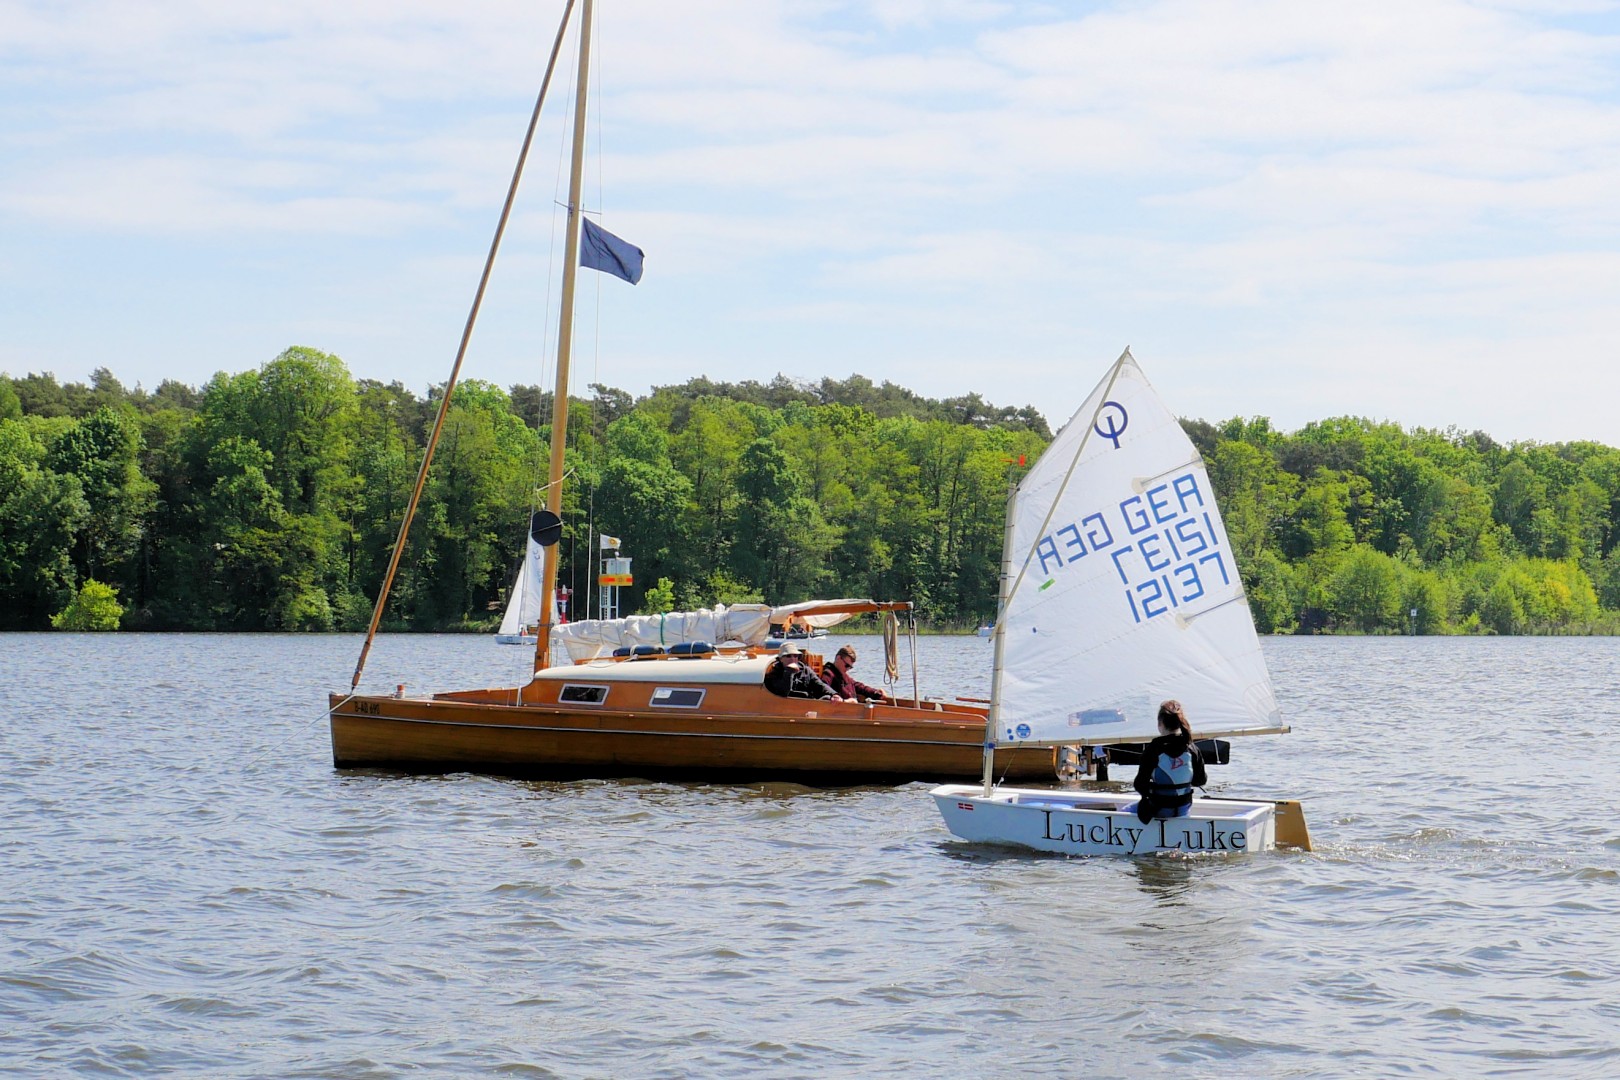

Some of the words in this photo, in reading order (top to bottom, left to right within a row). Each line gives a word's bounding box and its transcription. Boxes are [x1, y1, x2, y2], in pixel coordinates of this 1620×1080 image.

[1120, 473, 1204, 535] GER
[1126, 551, 1229, 623] 12137
[1041, 810, 1143, 855] Lucky
[1155, 818, 1246, 851] Luke
